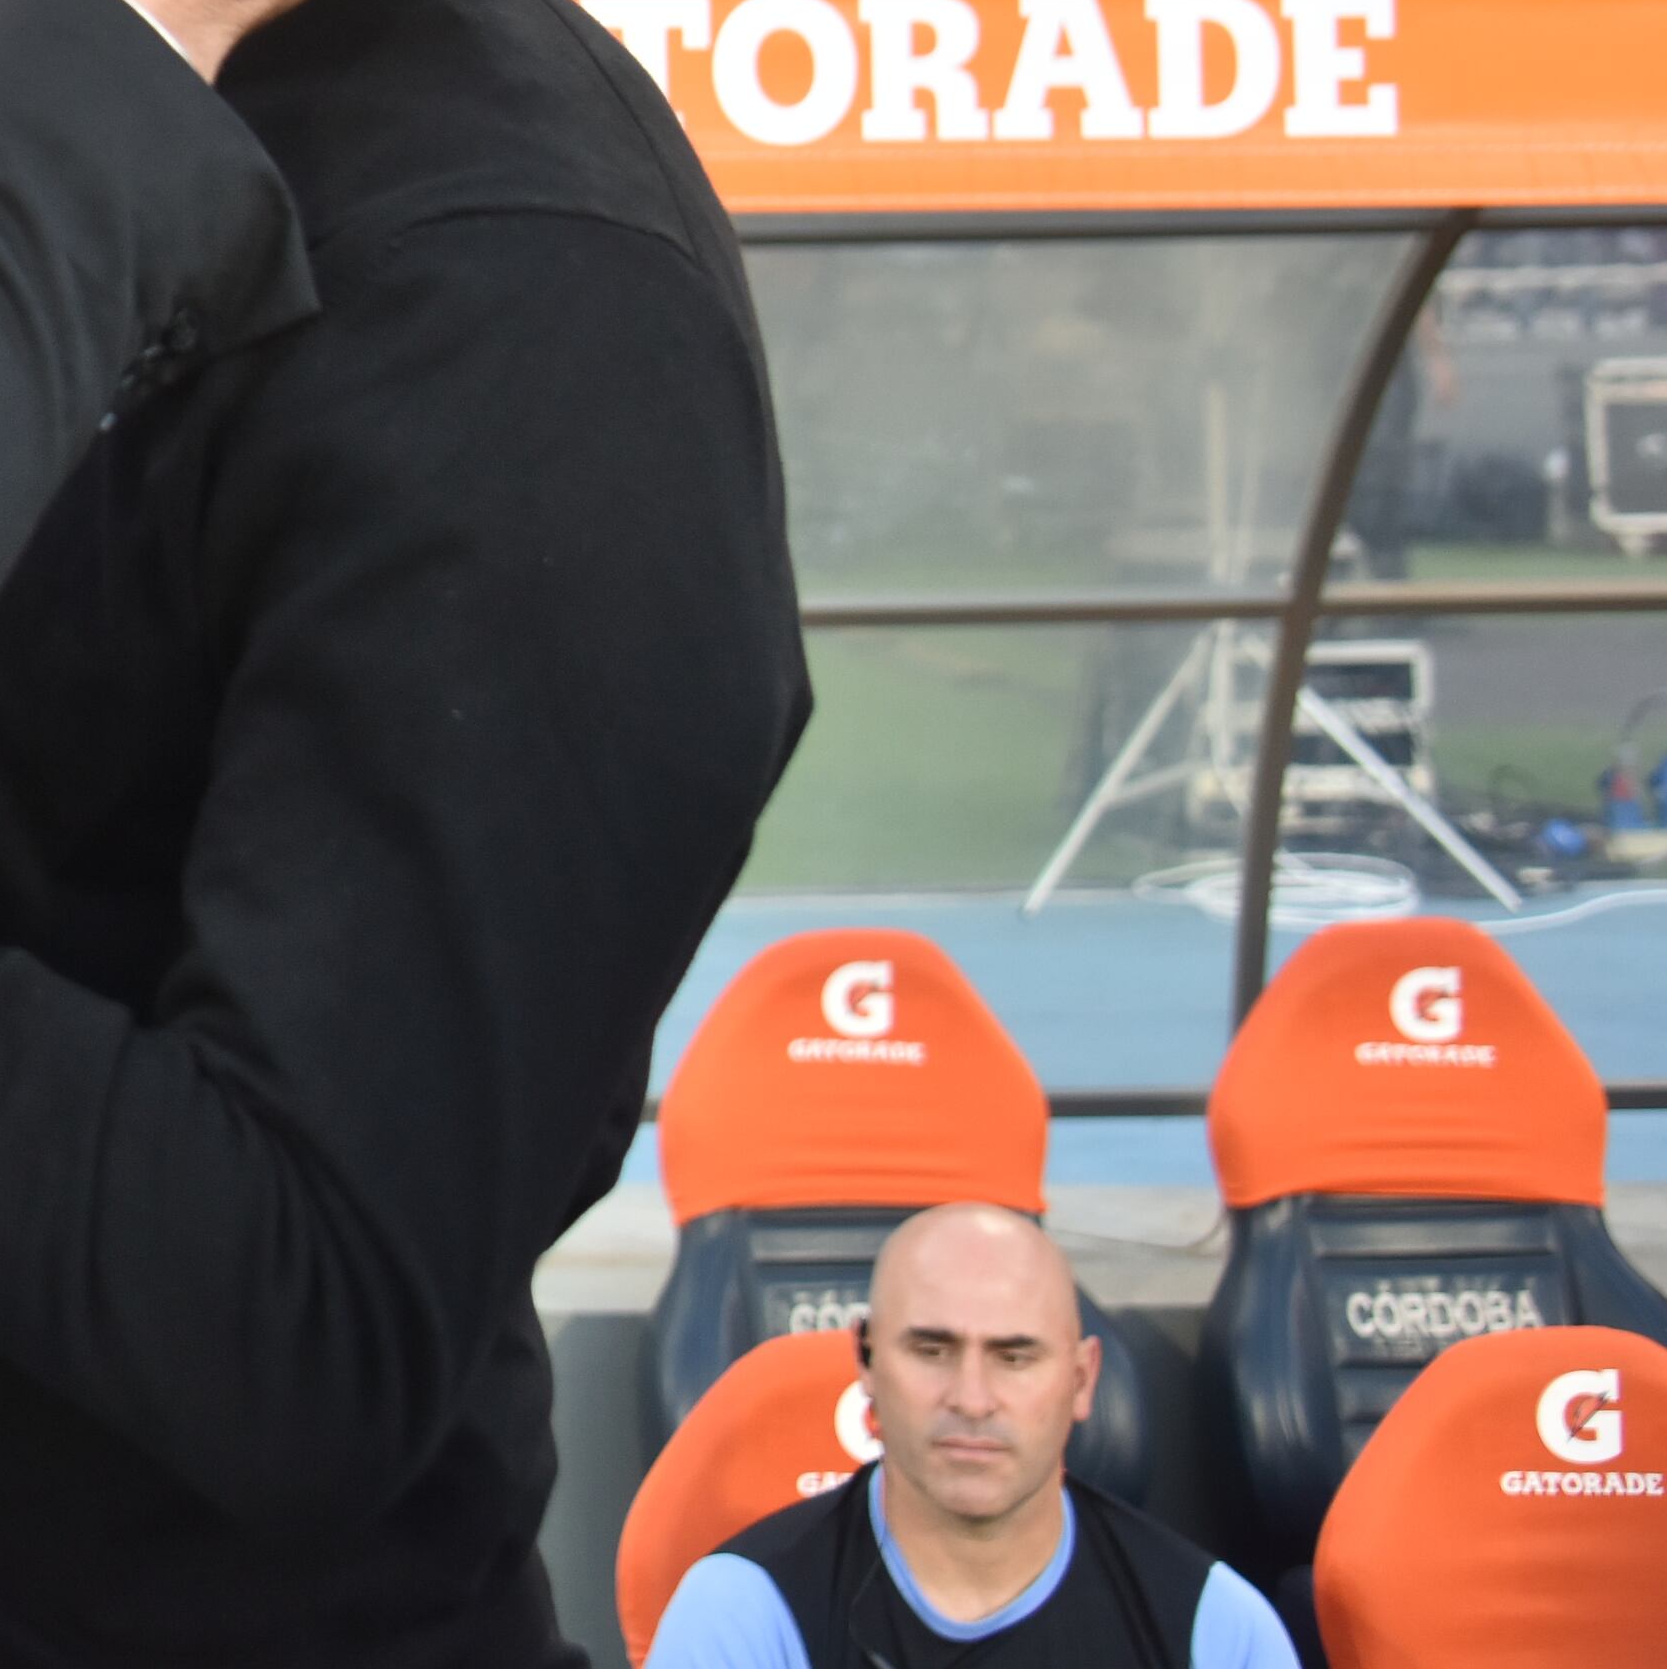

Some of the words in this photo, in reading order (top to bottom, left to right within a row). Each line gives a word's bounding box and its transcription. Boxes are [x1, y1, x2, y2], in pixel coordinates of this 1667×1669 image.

[820, 960, 895, 1038] G
[1389, 965, 1463, 1043] G
[1536, 1368, 1623, 1465] G
[1500, 1470, 1664, 1497] GATORADE
